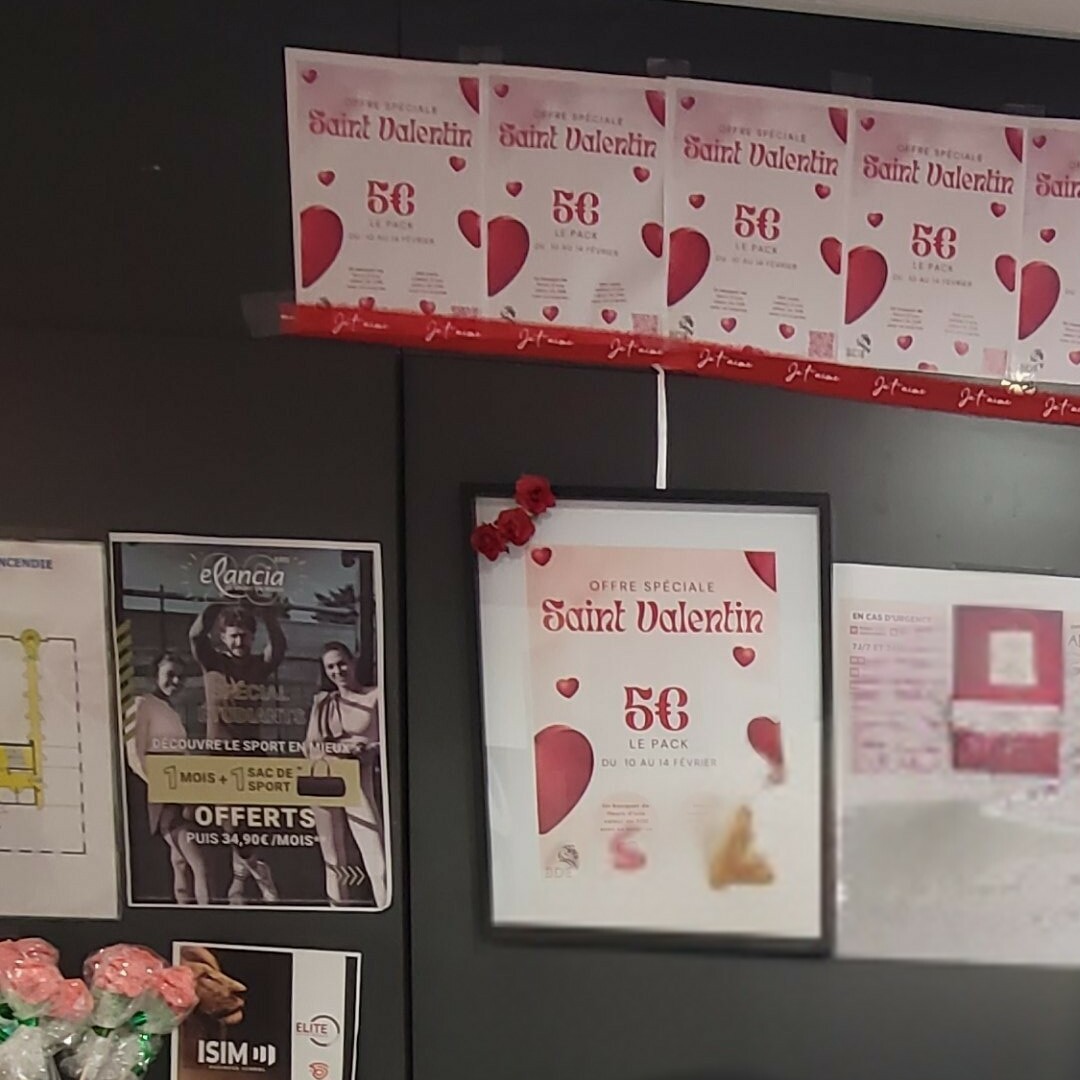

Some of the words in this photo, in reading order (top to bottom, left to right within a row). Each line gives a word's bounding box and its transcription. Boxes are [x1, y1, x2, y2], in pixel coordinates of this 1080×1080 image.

[309, 110, 370, 140] Saint
[378, 116, 472, 147] Valentin
[500, 123, 557, 150] Saint
[566, 128, 657, 158] Valentin
[683, 135, 743, 166] Saint
[750, 143, 839, 177] Valentin
[863, 154, 920, 185] Saint
[927, 162, 1014, 194] Valentin
[367, 180, 415, 216] 5€
[553, 190, 599, 226] 5€
[735, 203, 781, 240] 5€
[912, 224, 957, 259] 5€
[200, 556, 285, 598] elancia
[589, 580, 637, 592] OFFRE
[643, 580, 715, 593] SPÉCIALE
[542, 599, 626, 632] Saint
[636, 600, 764, 633] Valentin
[866, 613, 883, 621] CAS
[624, 686, 690, 732] 5€
[152, 738, 222, 751] DÉCOUVRE
[225, 740, 240, 750] LE
[242, 740, 286, 751] SPORT
[289, 741, 305, 752] EN
[629, 739, 646, 750] LE
[651, 739, 689, 750] PACK
[601, 758, 618, 767] DU
[624, 758, 637, 767] 10
[640, 758, 656, 767] AU
[659, 758, 670, 767] 14
[673, 756, 718, 768] FÉVRIER
[163, 765, 177, 790] 1
[180, 772, 216, 784] MOIS
[219, 775, 228, 785] +
[230, 766, 245, 791] 1
[247, 767, 274, 778] SAC
[277, 768, 293, 779] DE
[248, 781, 291, 792] SPORT
[195, 806, 316, 828] OFFERTS
[186, 832, 219, 845] PUIS
[296, 1022, 328, 1034] ELITE
[197, 1040, 248, 1065] ISIM
